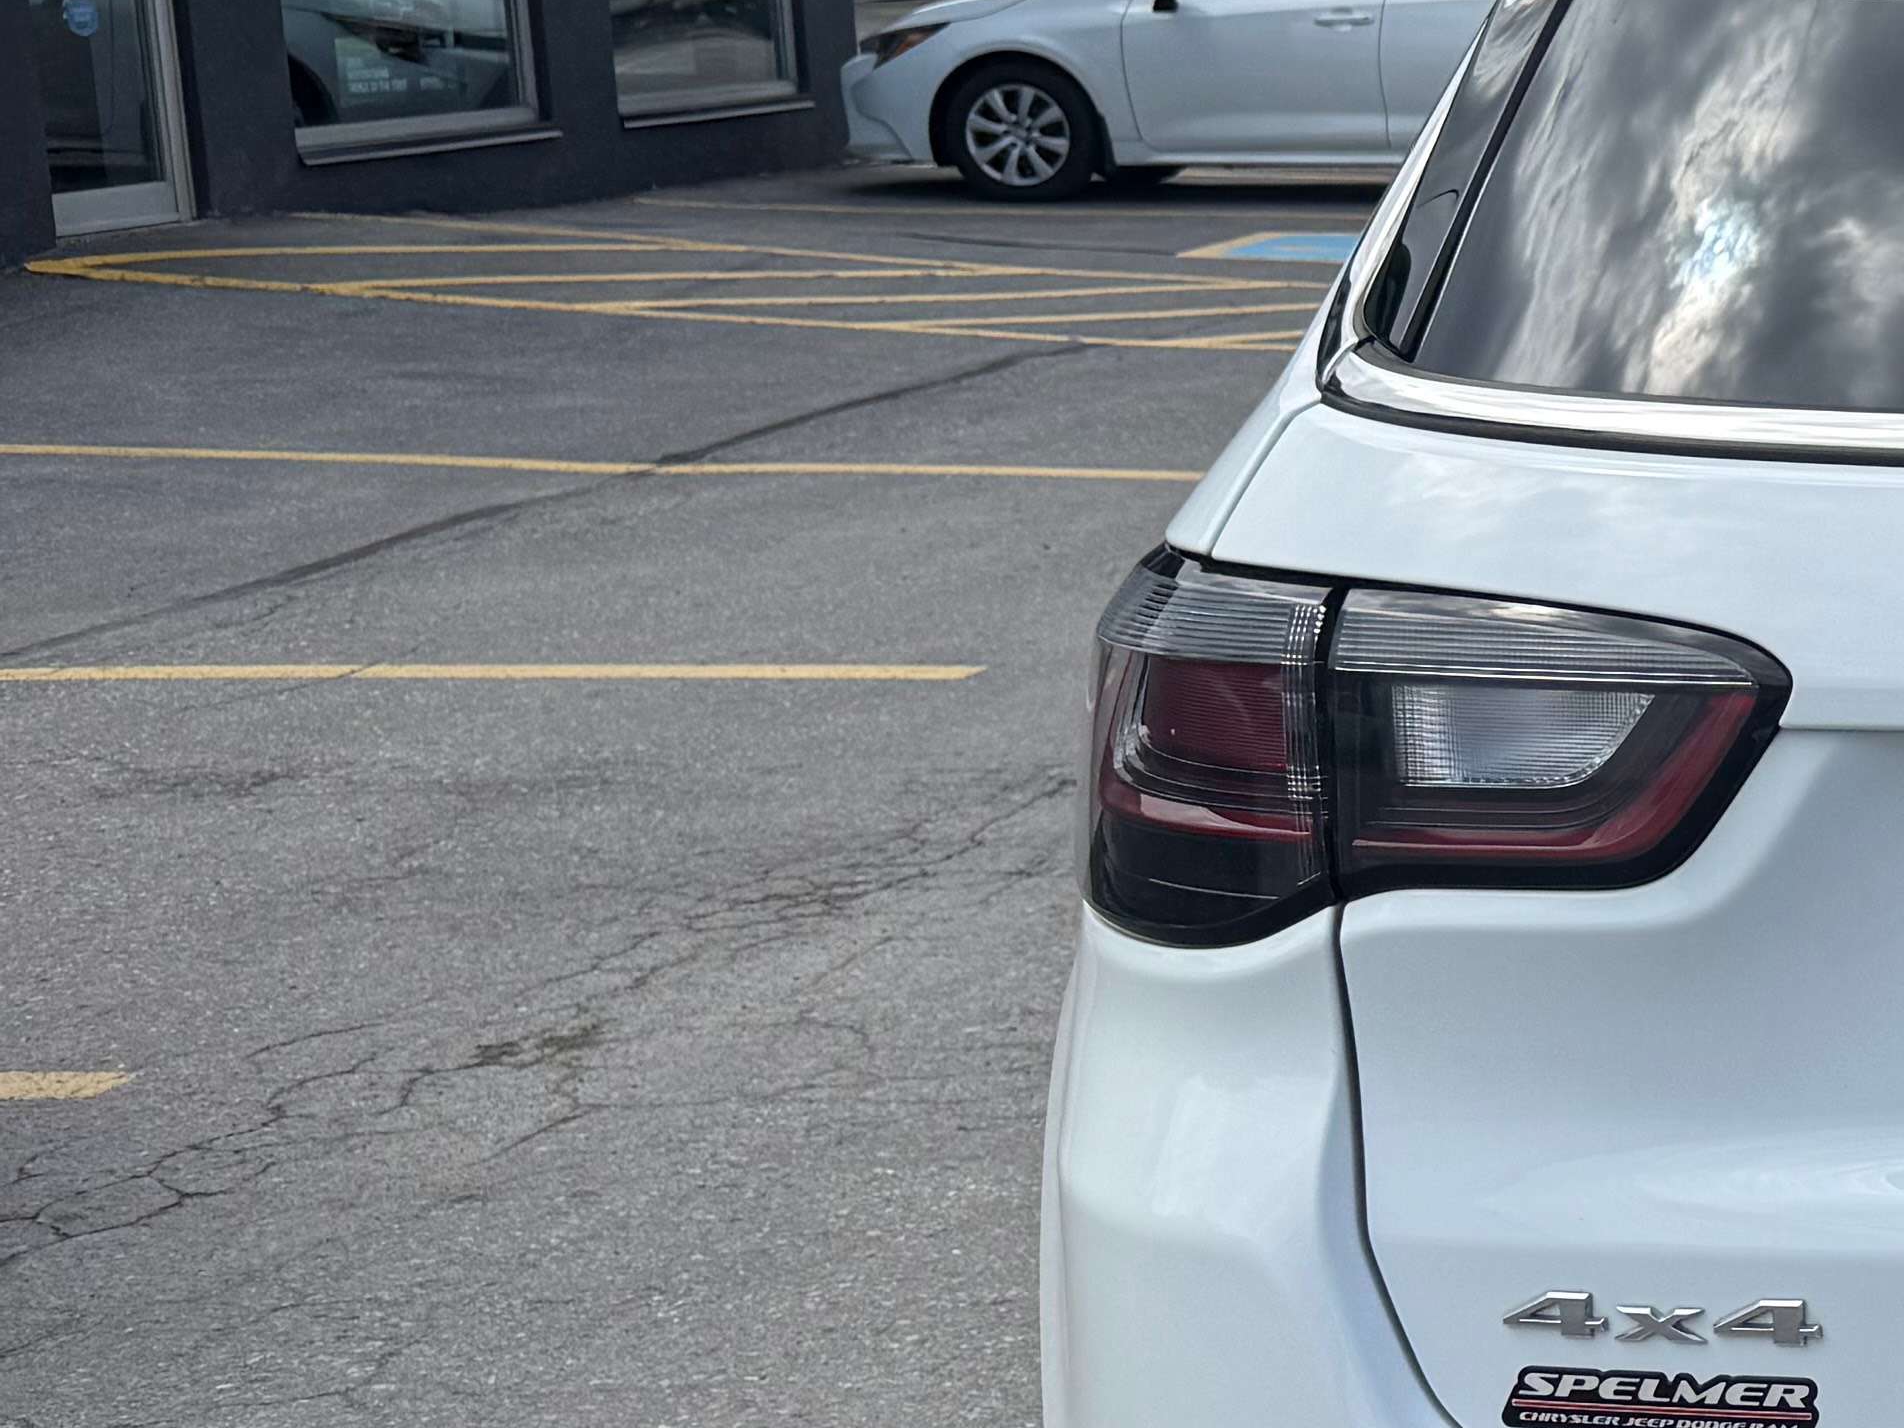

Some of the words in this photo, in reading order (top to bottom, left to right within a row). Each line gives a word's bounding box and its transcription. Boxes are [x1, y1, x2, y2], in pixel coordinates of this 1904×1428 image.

[1502, 1289, 1824, 1348] 4x4
[1518, 1371, 1813, 1409] SPELMER
[1518, 1410, 1621, 1427] CHRYSLER
[1621, 1416, 1674, 1428] JEEP
